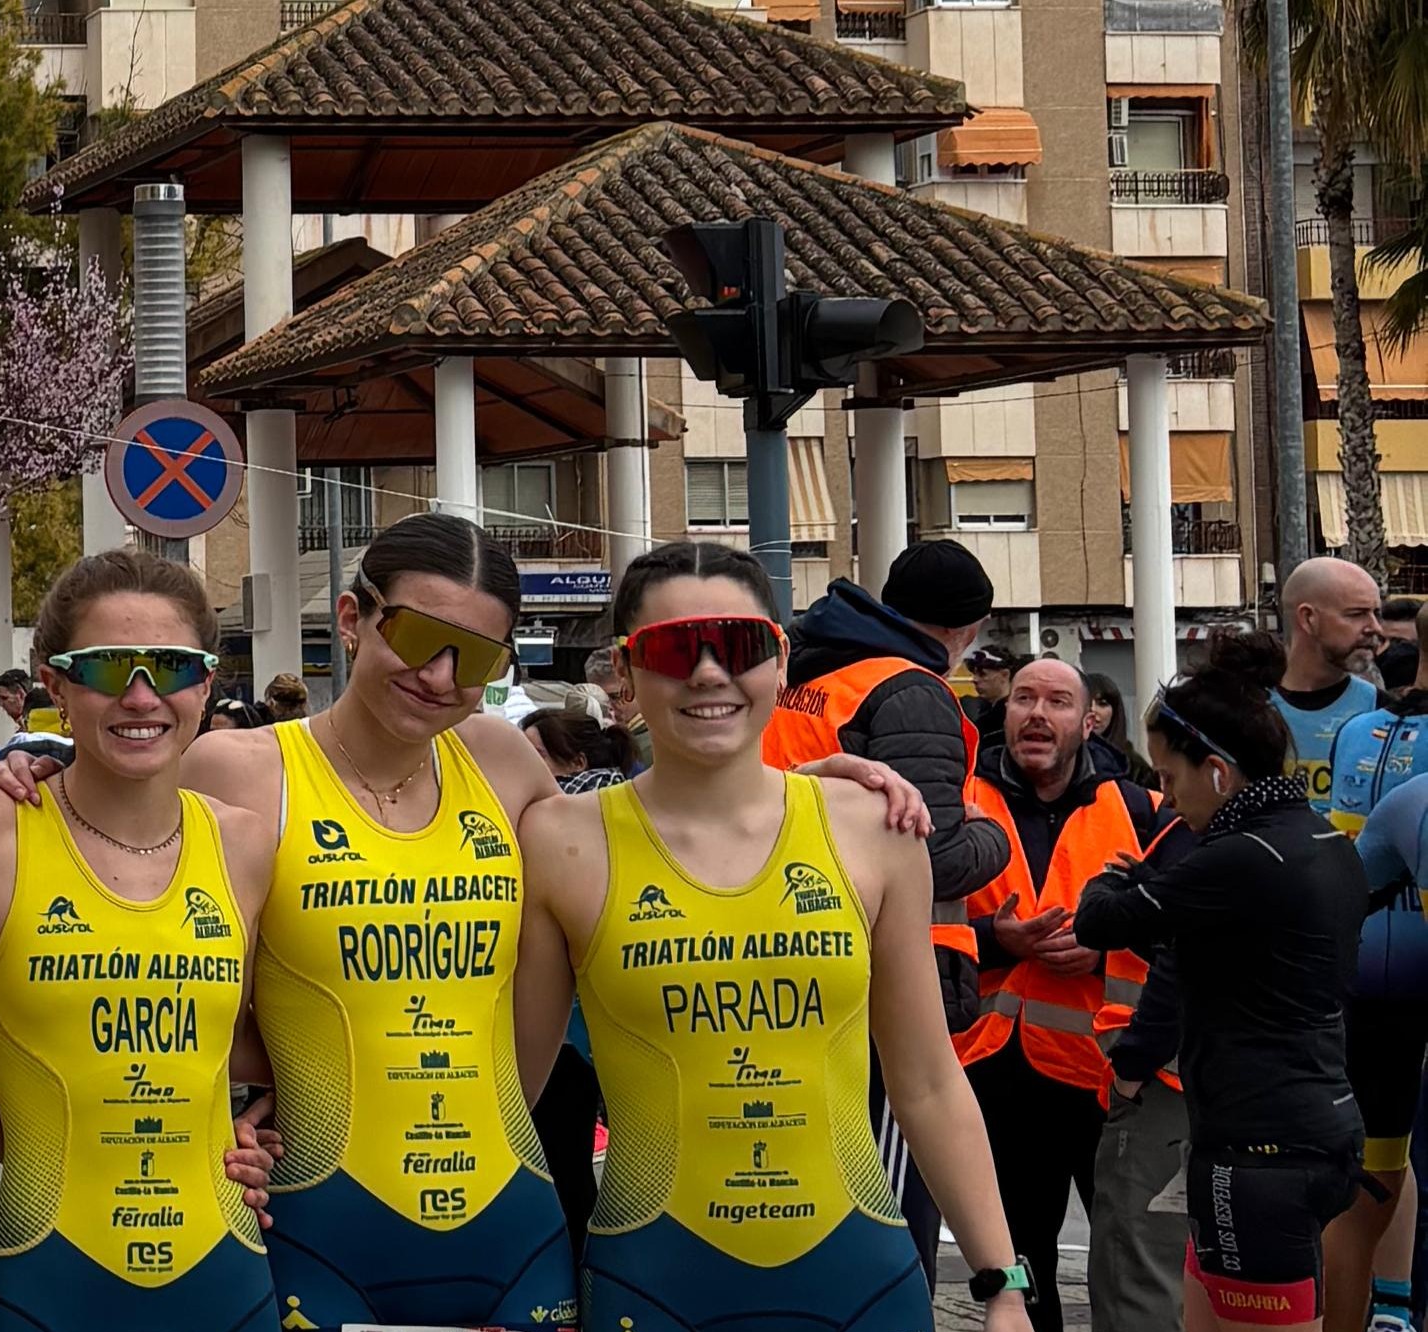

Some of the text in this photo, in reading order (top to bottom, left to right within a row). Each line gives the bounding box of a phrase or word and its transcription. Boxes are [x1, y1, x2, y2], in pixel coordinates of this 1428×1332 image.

[300, 873, 518, 911] TRIATLÓN ALBACETE
[339, 909, 501, 983] RODRÍGUEZ
[621, 930, 853, 970] TRIATLÓN ALBACETE
[28, 947, 240, 984] TRIATLÓN ALBACETE
[90, 982, 199, 1054] GARCÍA
[660, 977, 825, 1033] PARADA
[420, 1187, 466, 1213] res
[707, 1201, 815, 1224] Ingeteam
[126, 1241, 173, 1265] res
